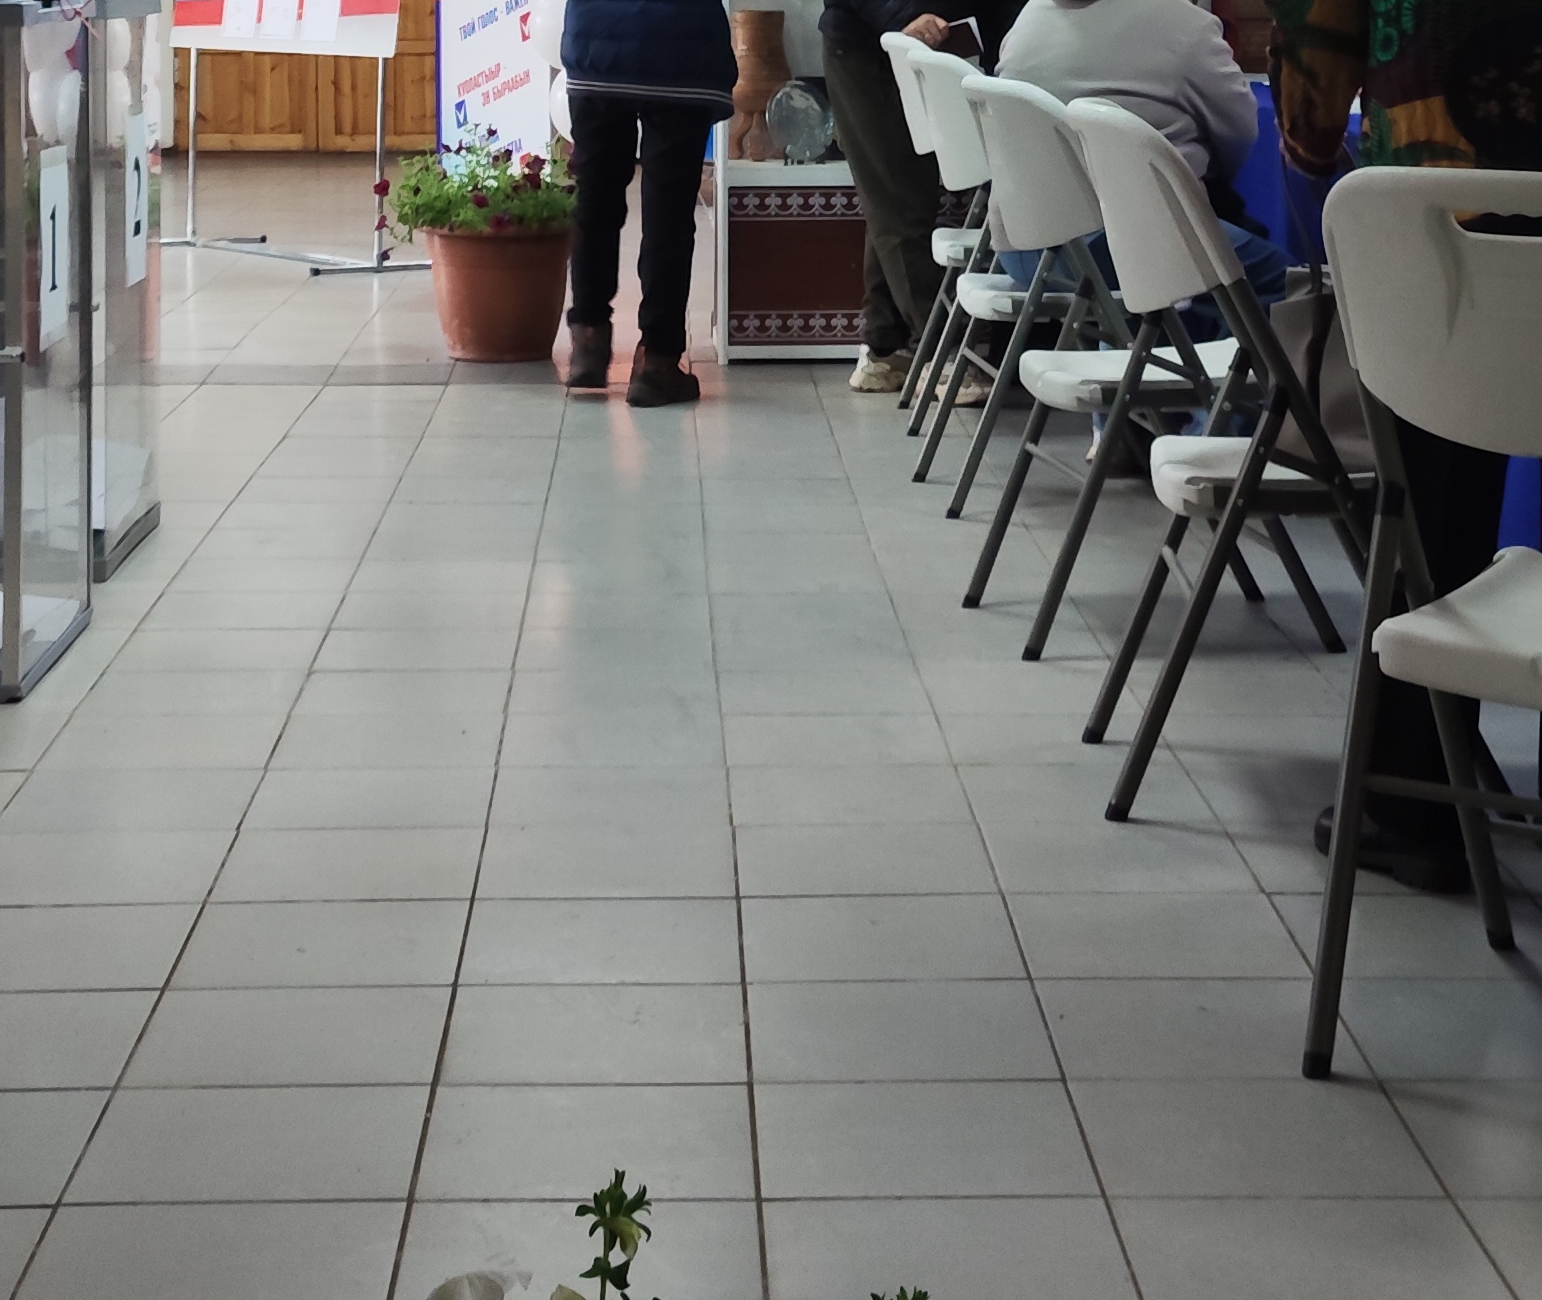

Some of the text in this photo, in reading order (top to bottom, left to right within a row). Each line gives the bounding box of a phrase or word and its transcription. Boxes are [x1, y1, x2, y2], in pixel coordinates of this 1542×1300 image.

[459, 17, 476, 41] ТВОЙ
[478, 7, 498, 31] ГОЛОС
[132, 156, 141, 237] 2
[49, 203, 57, 292] 1
